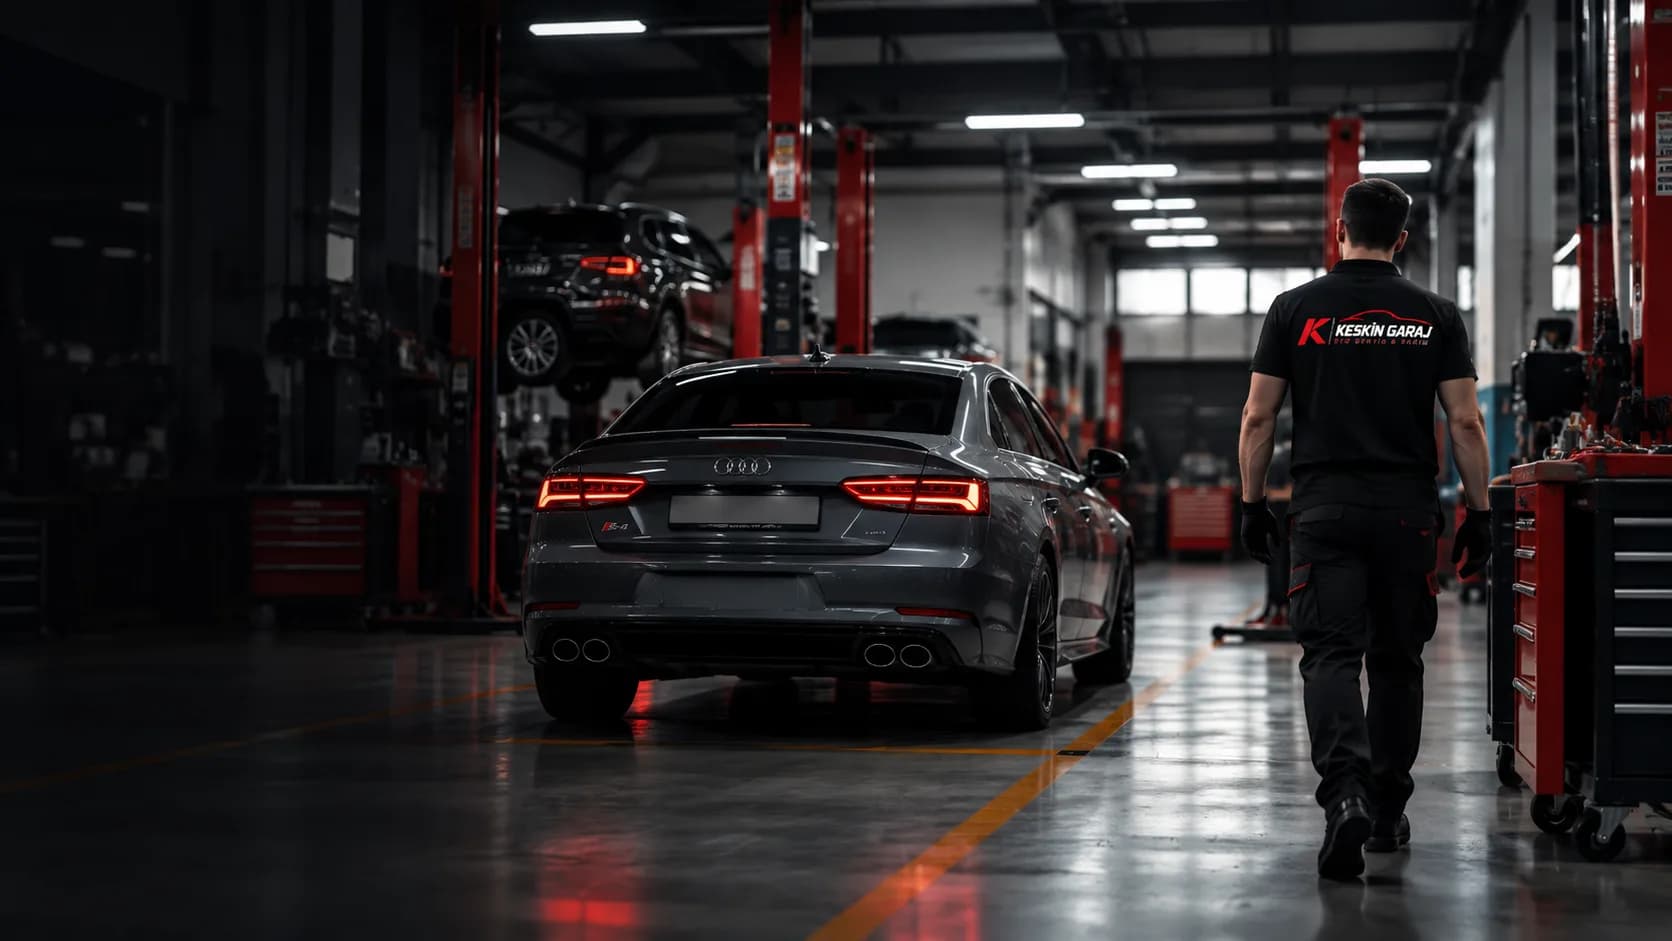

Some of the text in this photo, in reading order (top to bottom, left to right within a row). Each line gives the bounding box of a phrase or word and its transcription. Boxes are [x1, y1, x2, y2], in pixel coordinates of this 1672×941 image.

[1298, 317, 1331, 346] K
[1335, 322, 1433, 338] KESKİN GARAJ
